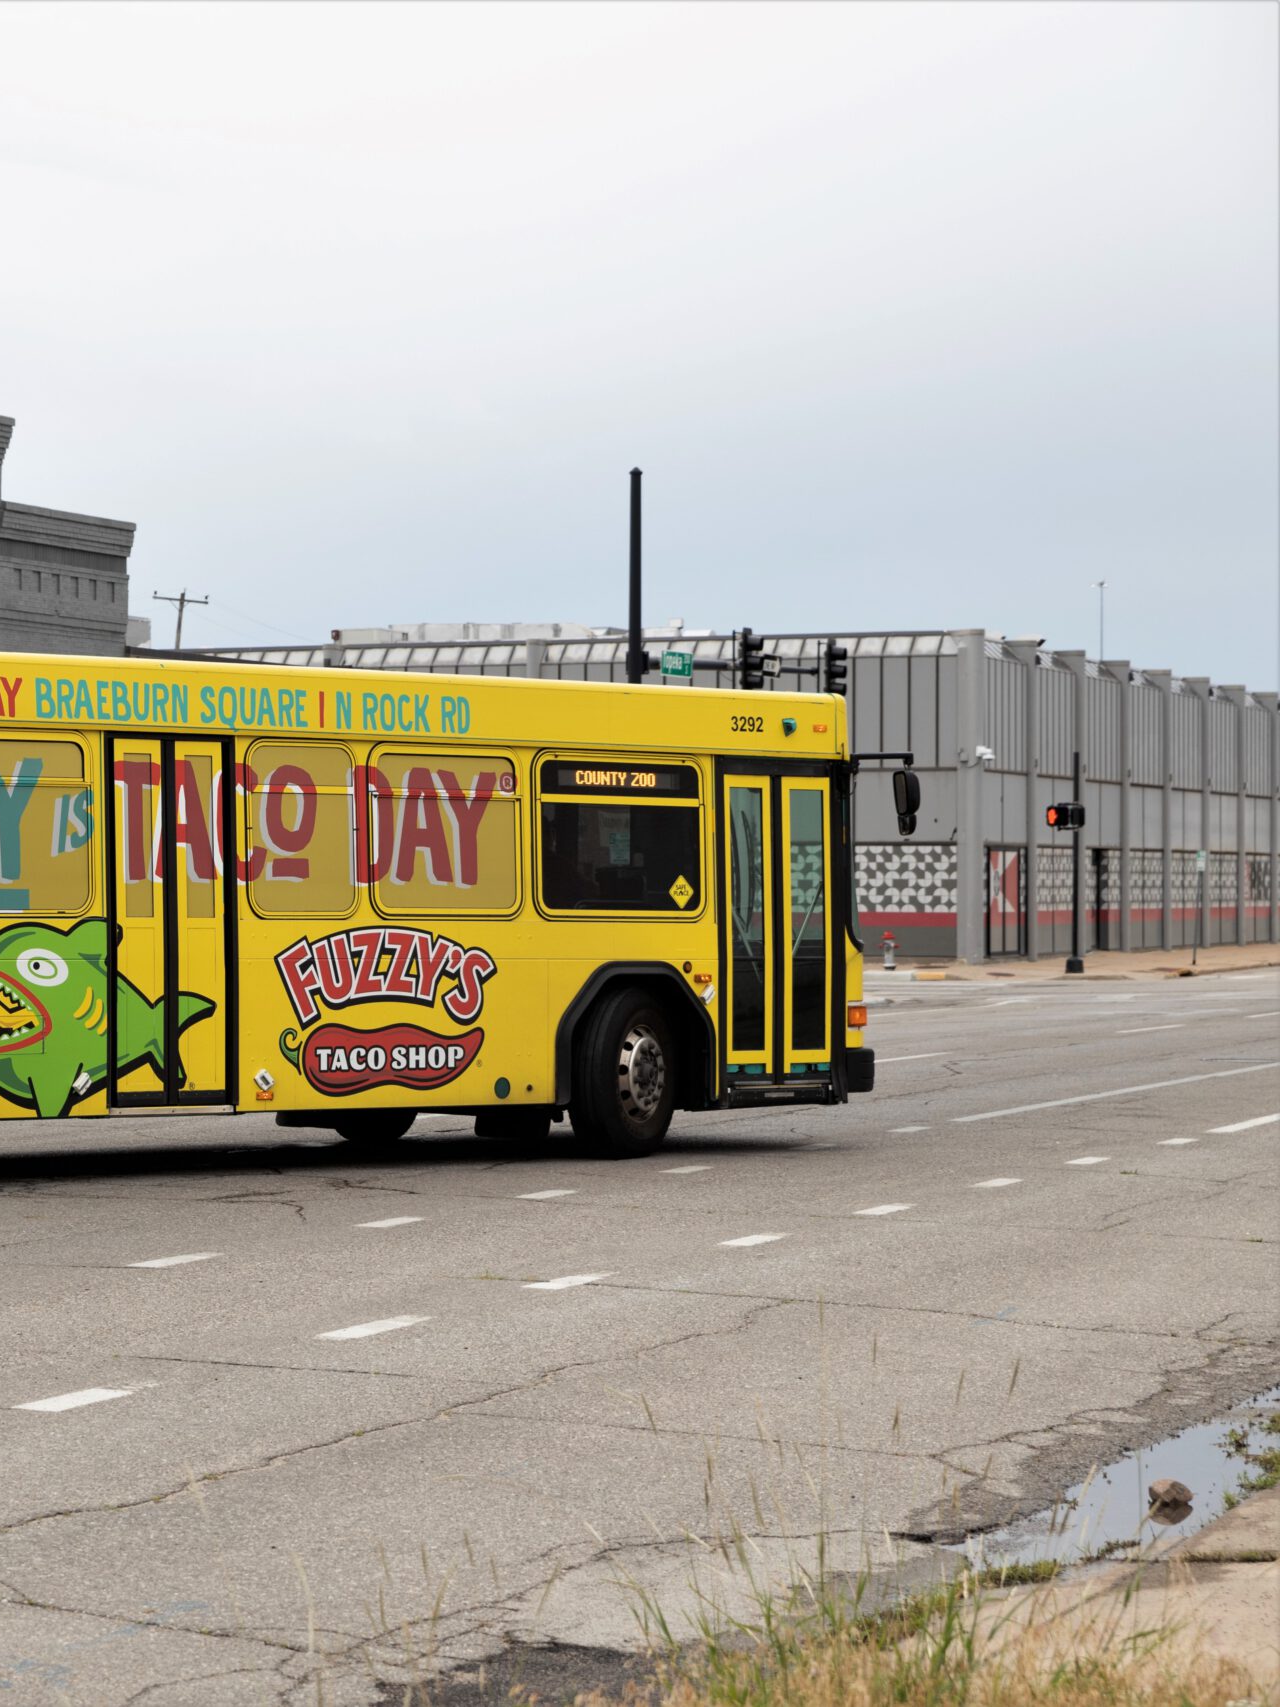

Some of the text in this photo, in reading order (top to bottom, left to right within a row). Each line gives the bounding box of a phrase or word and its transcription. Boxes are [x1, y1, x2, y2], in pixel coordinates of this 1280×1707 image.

[35, 677, 189, 724] BRAEBURN
[200, 685, 308, 732] SQUARE
[362, 692, 431, 733] ROCK
[441, 695, 471, 735] RD
[731, 715, 764, 733] 3292
[575, 770, 627, 786] COUNTY
[50, 788, 95, 857] IS
[113, 760, 317, 885] TACO
[276, 926, 496, 1027] FUZZY'S
[316, 1045, 465, 1072] TACO SHOP
